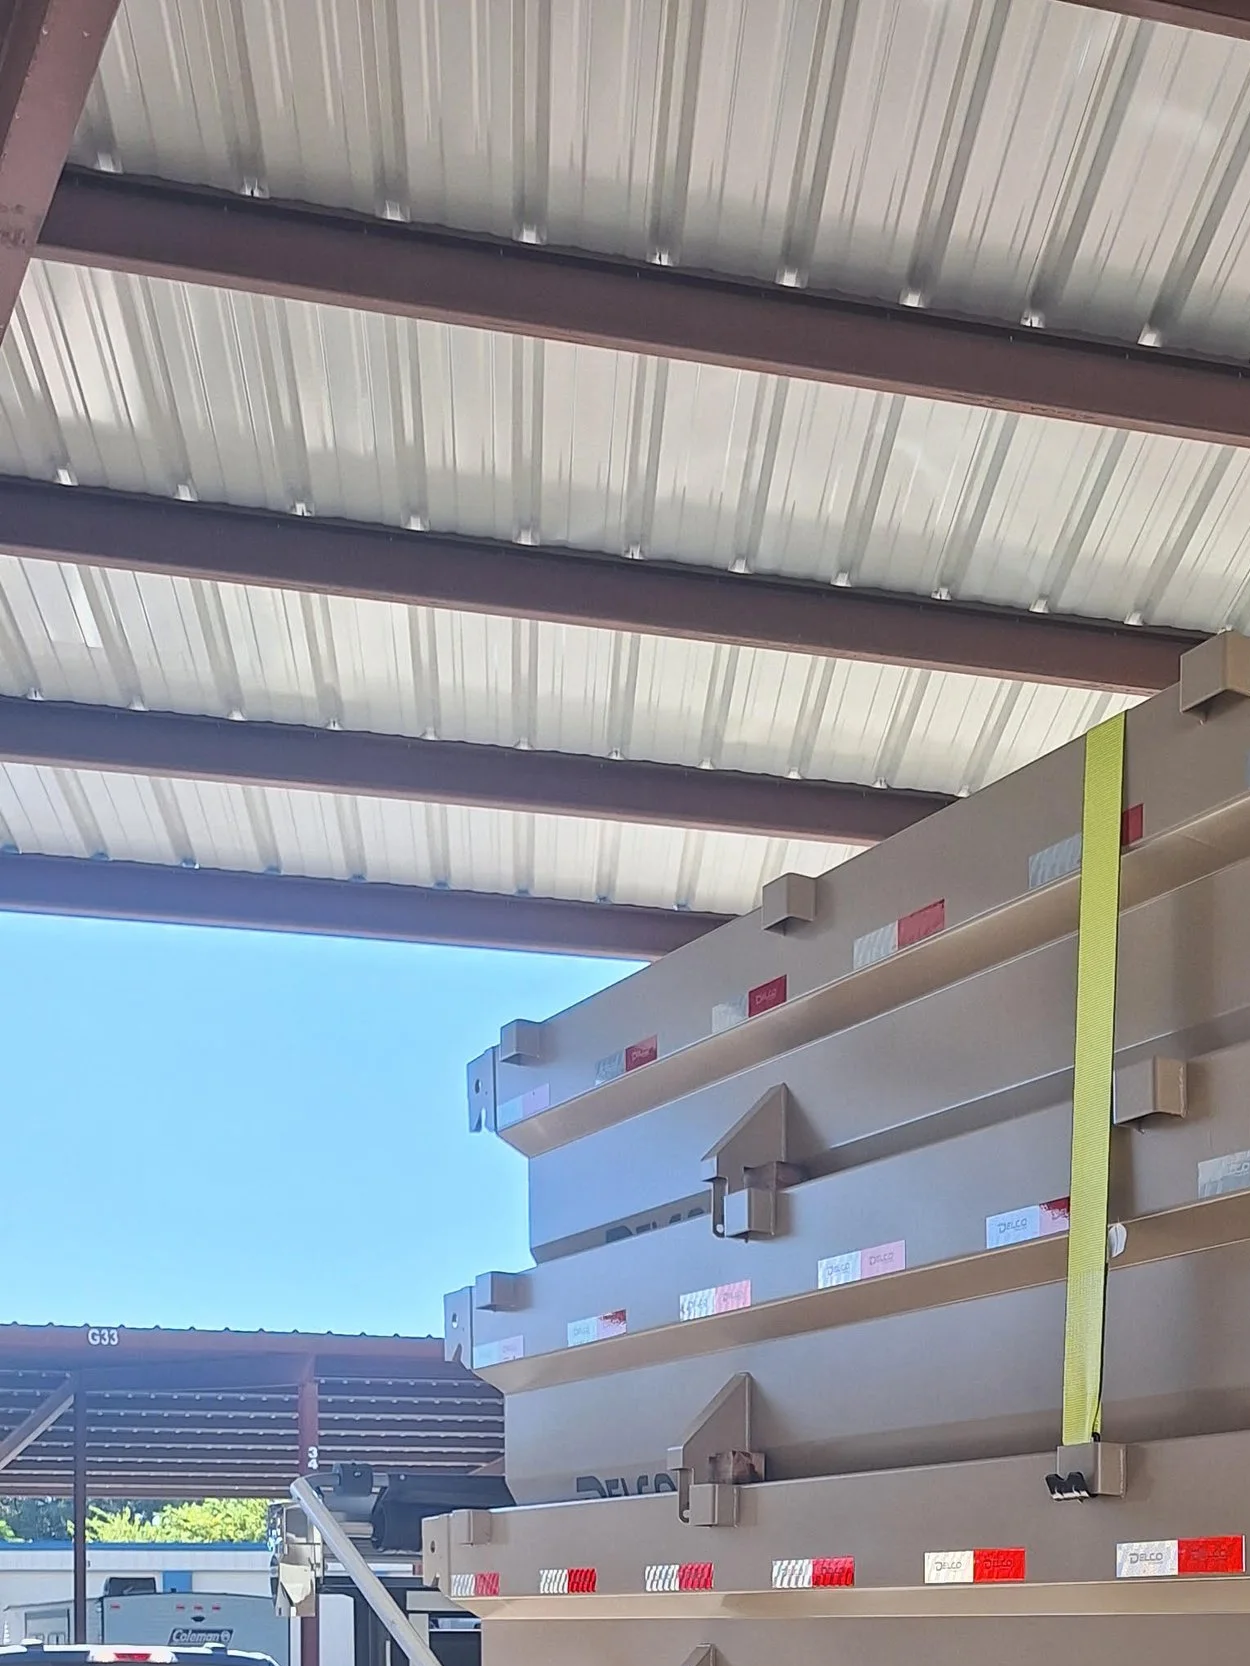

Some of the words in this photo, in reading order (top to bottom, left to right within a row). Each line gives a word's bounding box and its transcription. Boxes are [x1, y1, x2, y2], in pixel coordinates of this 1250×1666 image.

[997, 1218, 1028, 1234] DELCO
[88, 1328, 119, 1346] G33
[1129, 1552, 1164, 1565] DELCO
[935, 1561, 963, 1572] DELCO
[172, 1629, 220, 1643] Coleman
